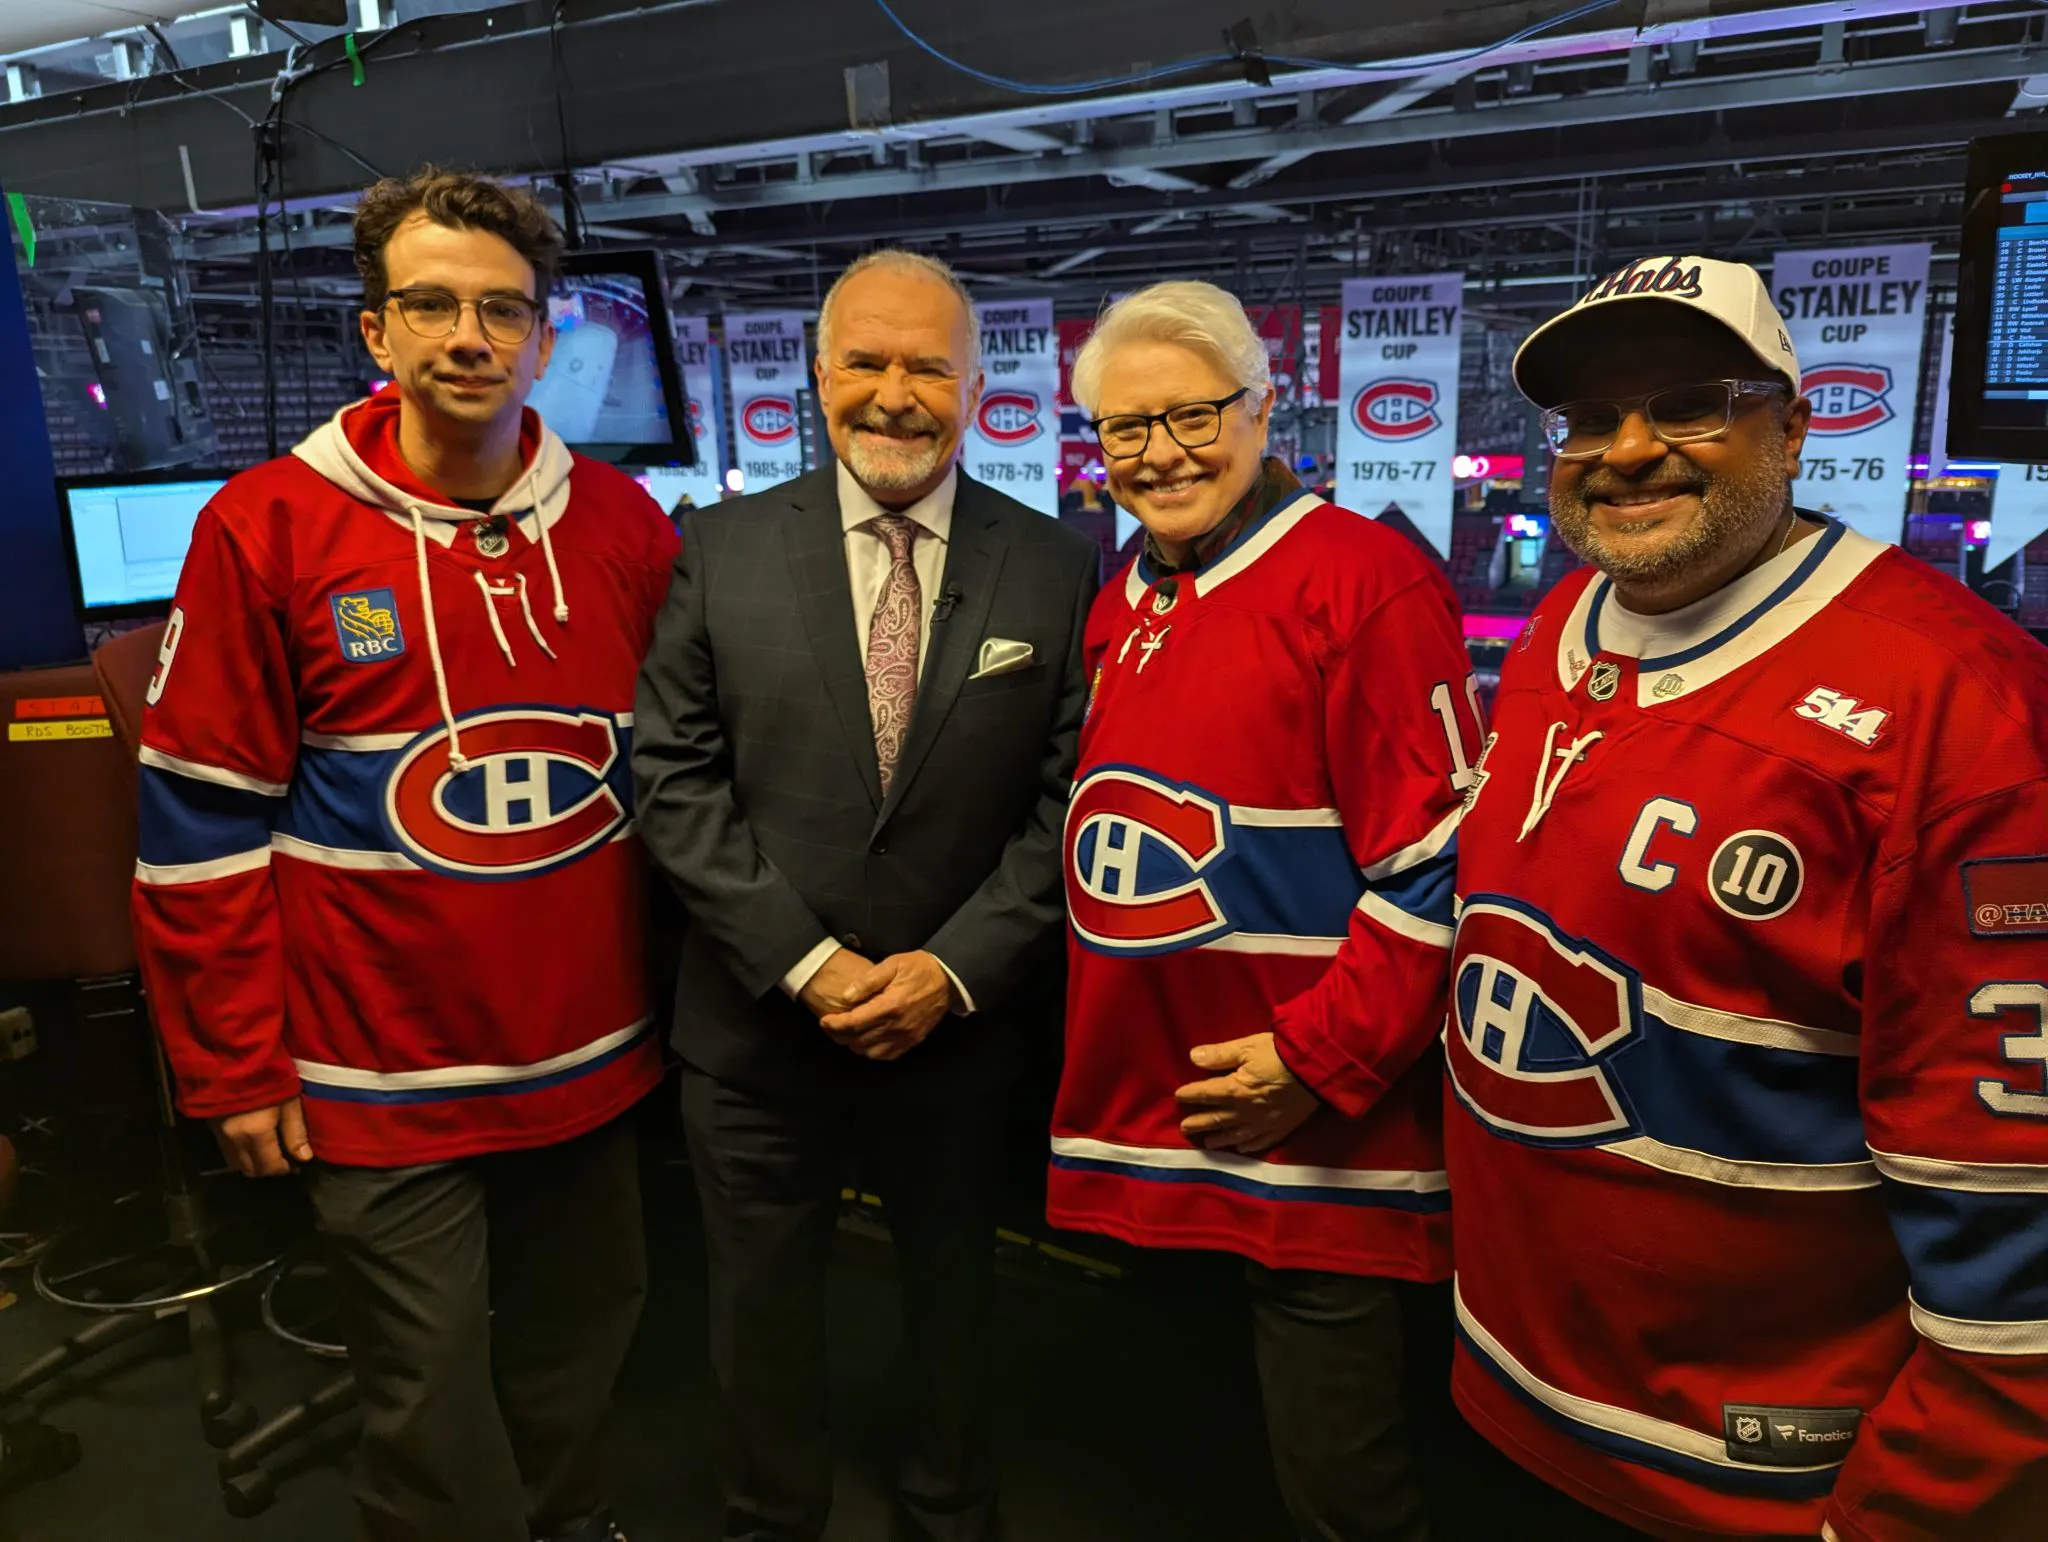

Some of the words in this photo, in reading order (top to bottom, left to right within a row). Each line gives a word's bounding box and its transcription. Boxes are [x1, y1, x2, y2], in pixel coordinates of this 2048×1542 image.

[1812, 256, 1891, 279] COUPE
[1372, 284, 1433, 303] COUPE
[1778, 279, 1922, 321] STANLEY
[983, 308, 1030, 325] COUPE
[1347, 306, 1457, 339] STANLEY
[744, 320, 785, 336] COUPE
[1821, 324, 1868, 343] CUP
[730, 338, 801, 364] STANLEY
[980, 327, 1050, 356] TANLEY
[1381, 343, 1418, 360] CUP
[756, 367, 780, 381] CUP
[993, 360, 1021, 375] CUP
[978, 462, 1044, 482] 1978-79
[1352, 461, 1437, 481] 1976-77
[1799, 457, 1885, 482] 75-76
[348, 636, 399, 658] RBC
[1791, 684, 1894, 749] 514
[25, 725, 53, 738] RDS
[65, 723, 112, 738] BOOTH
[1619, 795, 1700, 894] C
[1720, 844, 1789, 906] 10
[1798, 1429, 1854, 1443] Fanatics
